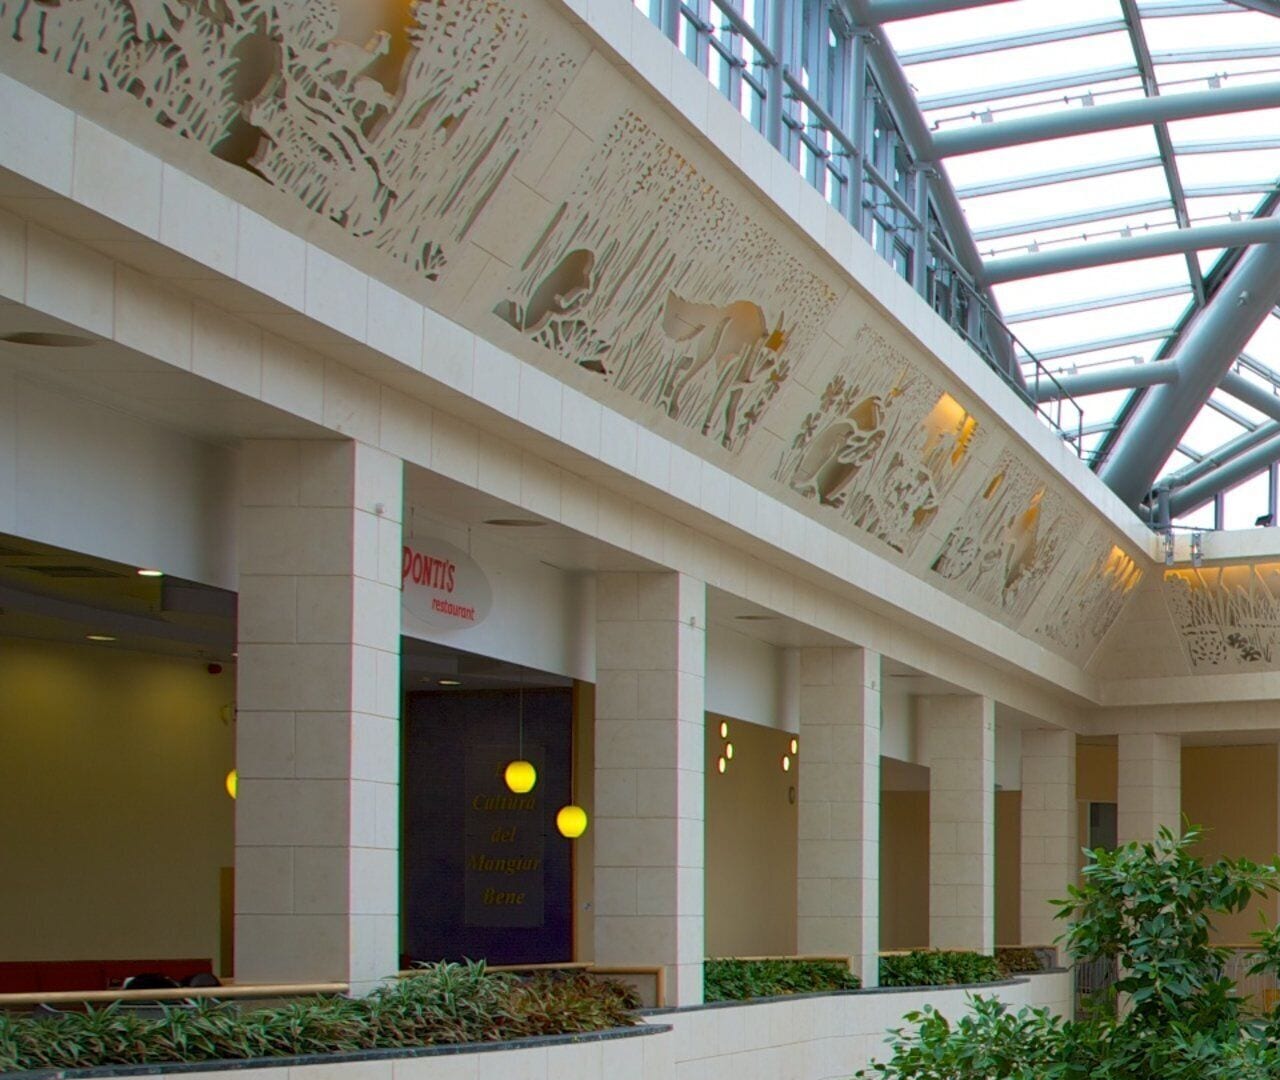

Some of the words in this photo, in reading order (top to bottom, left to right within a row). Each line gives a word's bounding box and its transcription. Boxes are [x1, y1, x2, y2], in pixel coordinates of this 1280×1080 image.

[432, 599, 475, 621] restaurant
[472, 794, 537, 811] Cultura
[490, 826, 517, 843] del
[467, 854, 541, 876] Mangiar
[481, 887, 526, 905] Bene
